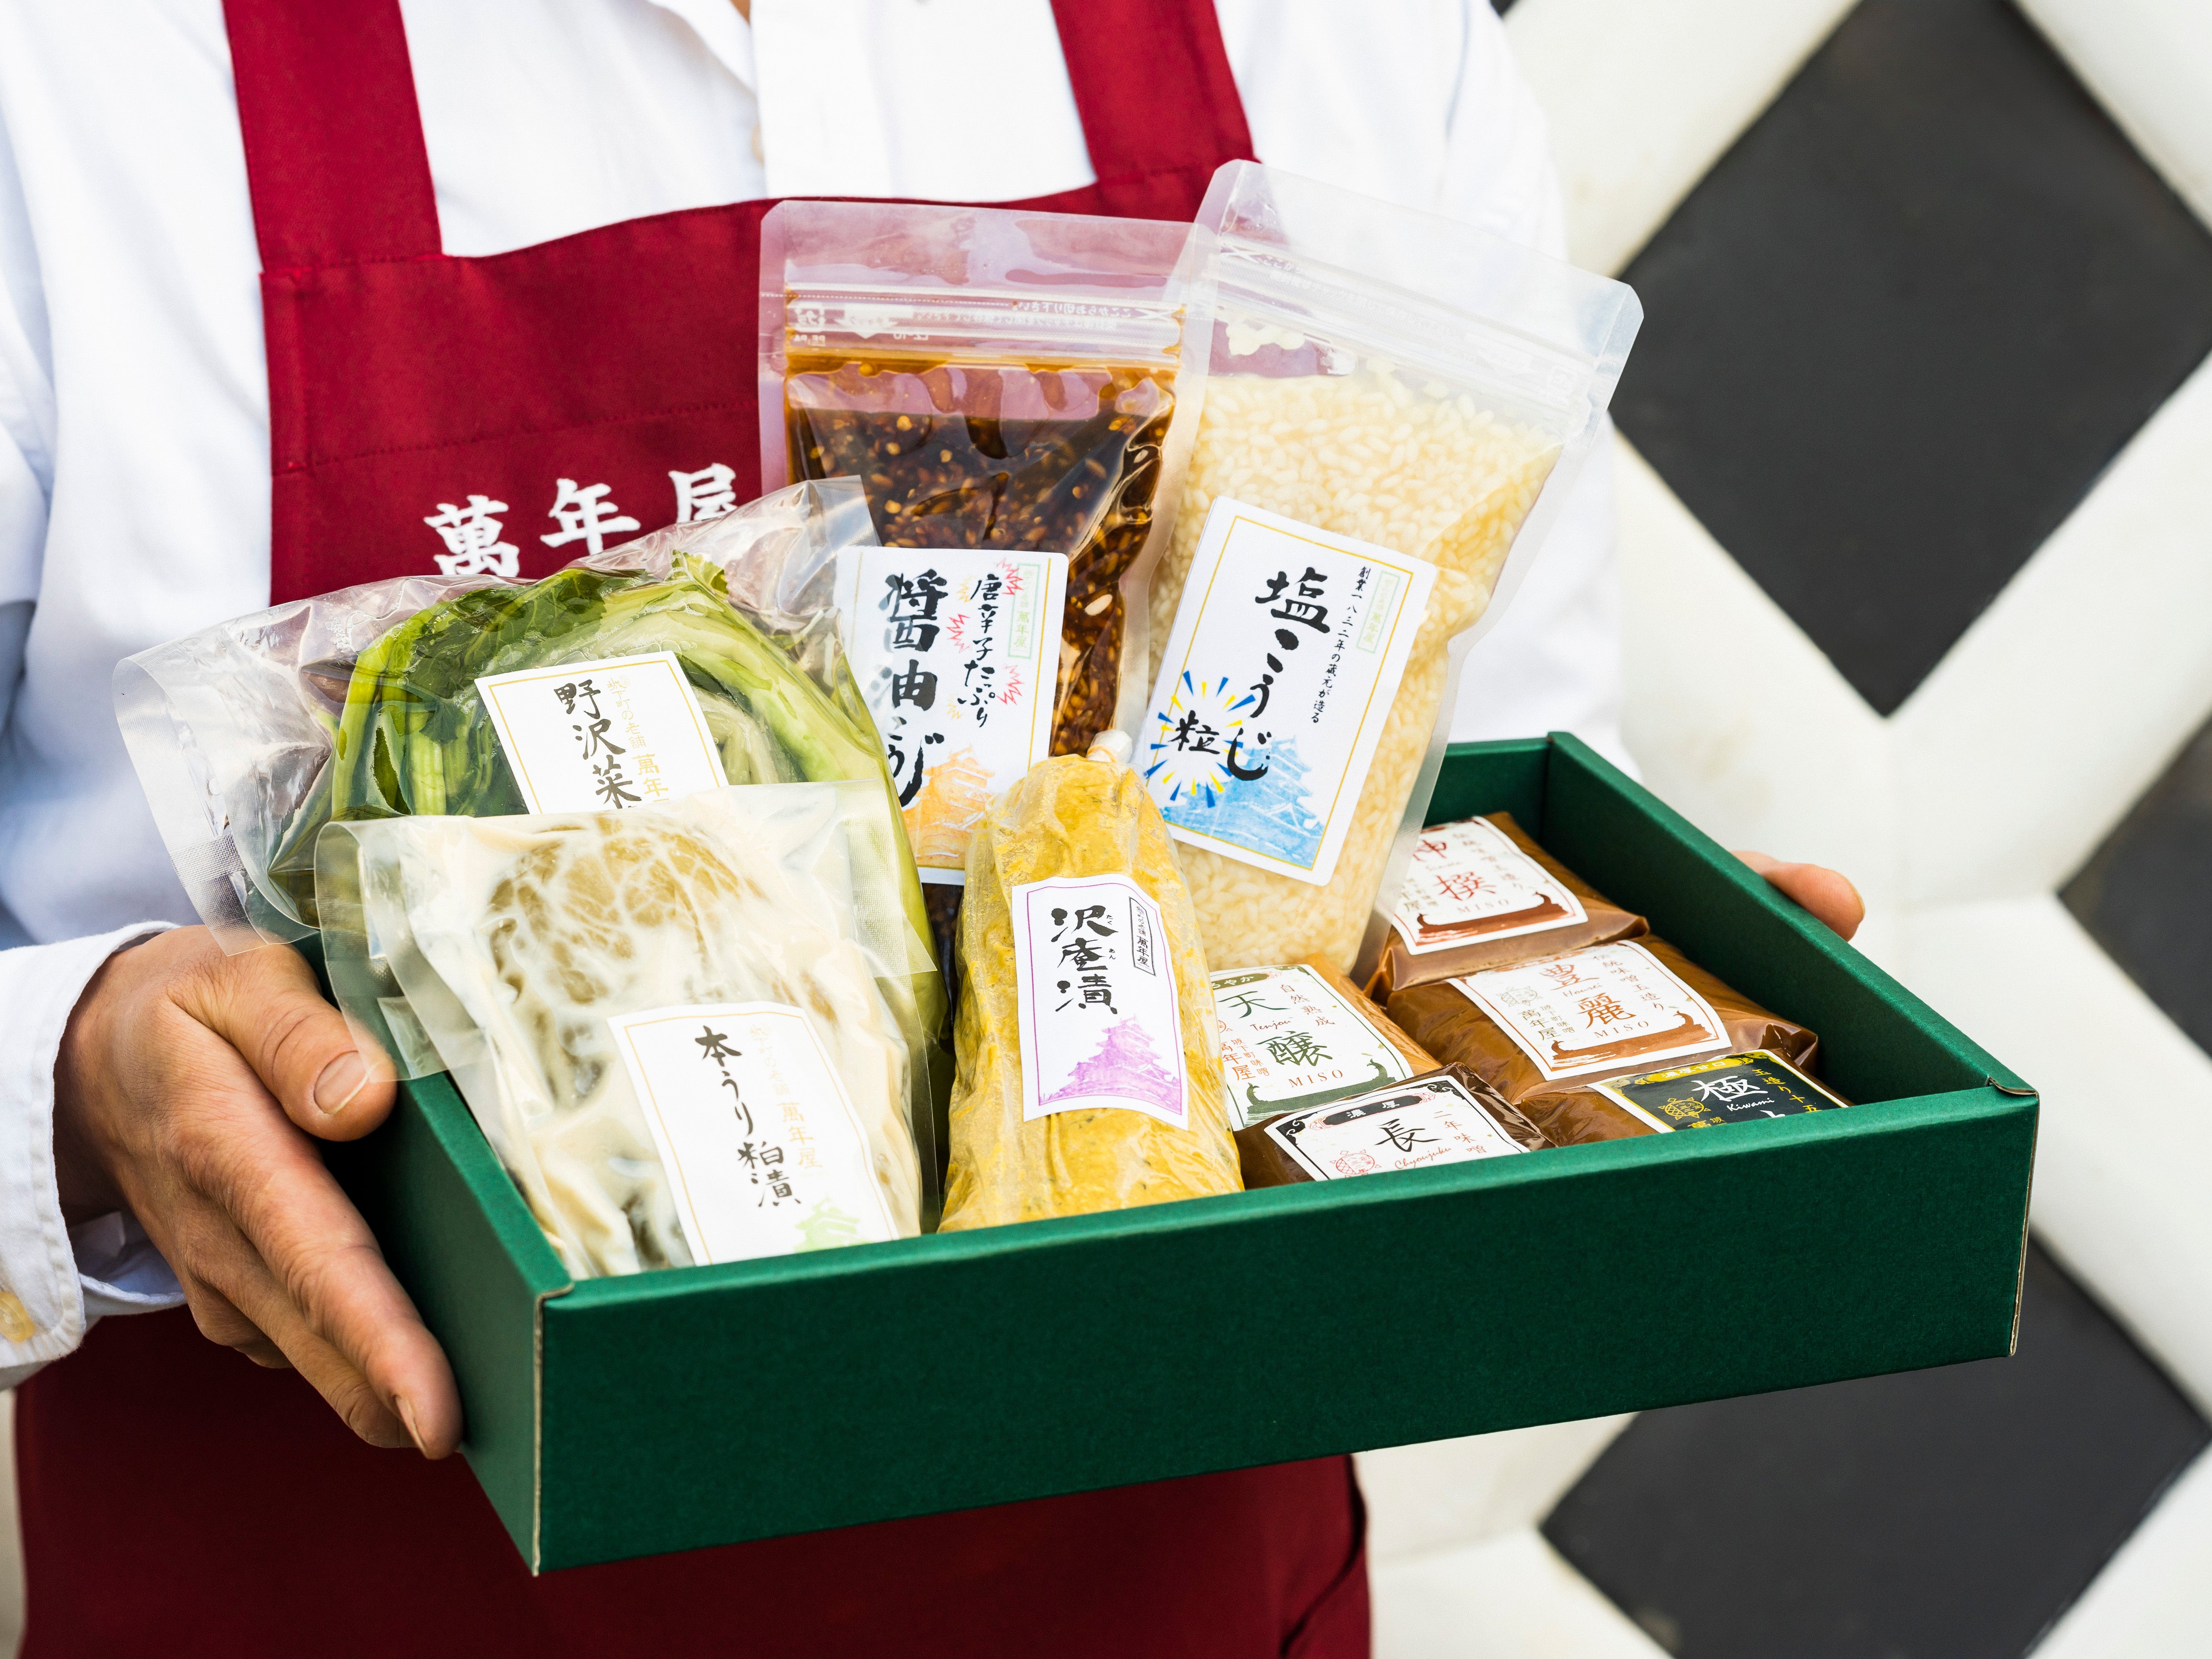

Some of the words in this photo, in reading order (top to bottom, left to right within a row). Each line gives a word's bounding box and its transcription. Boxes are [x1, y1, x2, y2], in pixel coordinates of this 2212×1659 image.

[423, 463, 737, 577] 萬年屋
[554, 679, 642, 809] 野沢菜
[1171, 710, 1220, 755] 粒
[632, 753, 669, 802] 萬年
[1280, 984, 1336, 1027] 自然熟成
[1594, 1021, 1649, 1039] MISO
[1288, 1069, 1343, 1088] MISO
[1691, 1075, 1768, 1102] 極
[695, 1025, 801, 1207] 本うり粕漬
[1726, 1097, 1775, 1112] Kiwami
[777, 1102, 823, 1169] 萬年屋
[1374, 1118, 1443, 1152] 長
[1433, 1111, 1487, 1154] 二年味噌
